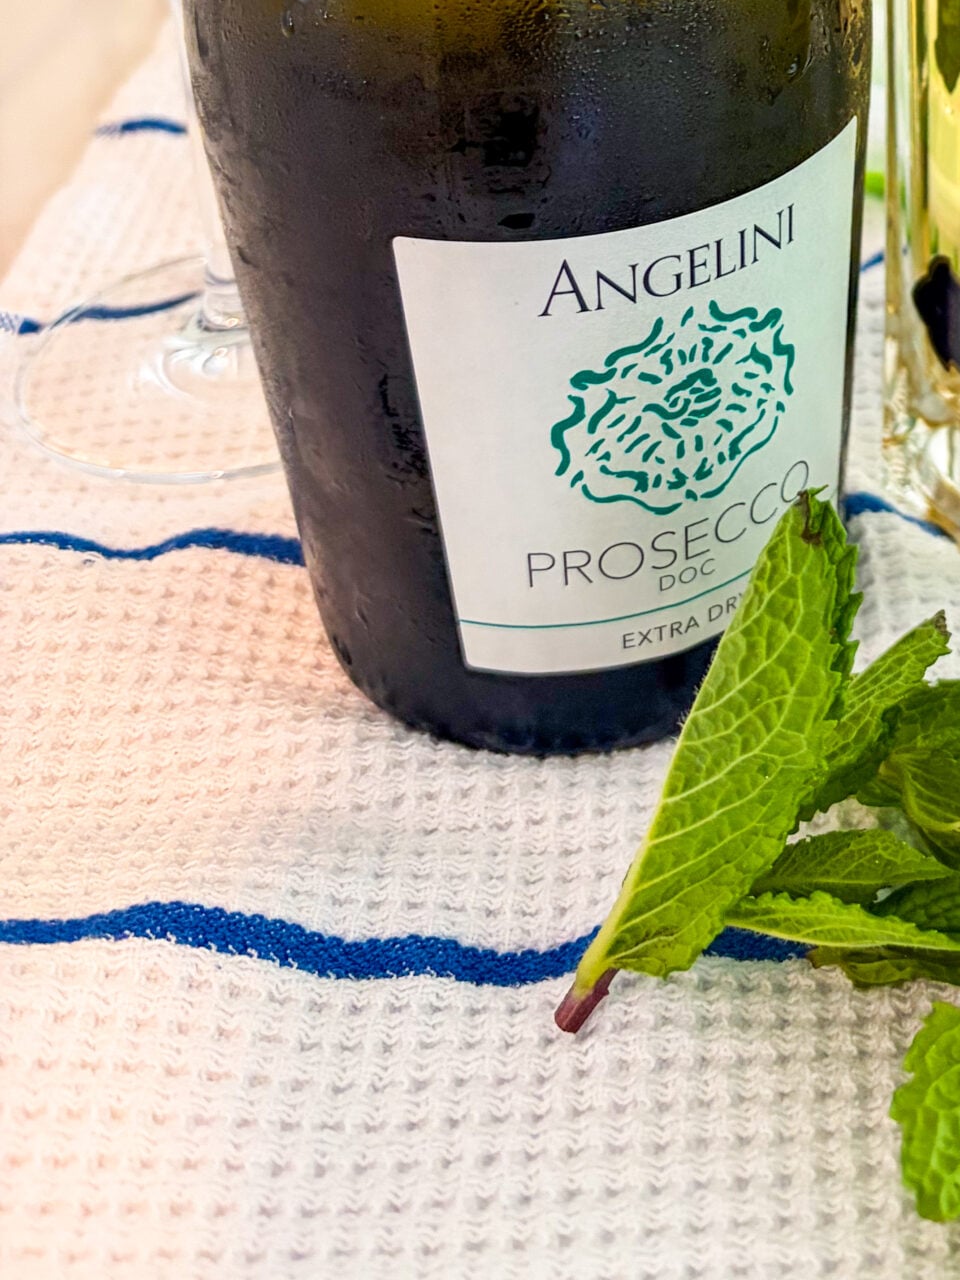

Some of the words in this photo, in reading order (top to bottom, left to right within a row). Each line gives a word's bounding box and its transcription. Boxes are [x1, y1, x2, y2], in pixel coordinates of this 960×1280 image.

[537, 202, 796, 318] ANGELINI
[526, 460, 810, 589] PROSECCO
[658, 558, 717, 593] DOC
[622, 615, 701, 650] EXTRA
[708, 592, 743, 622] DR
